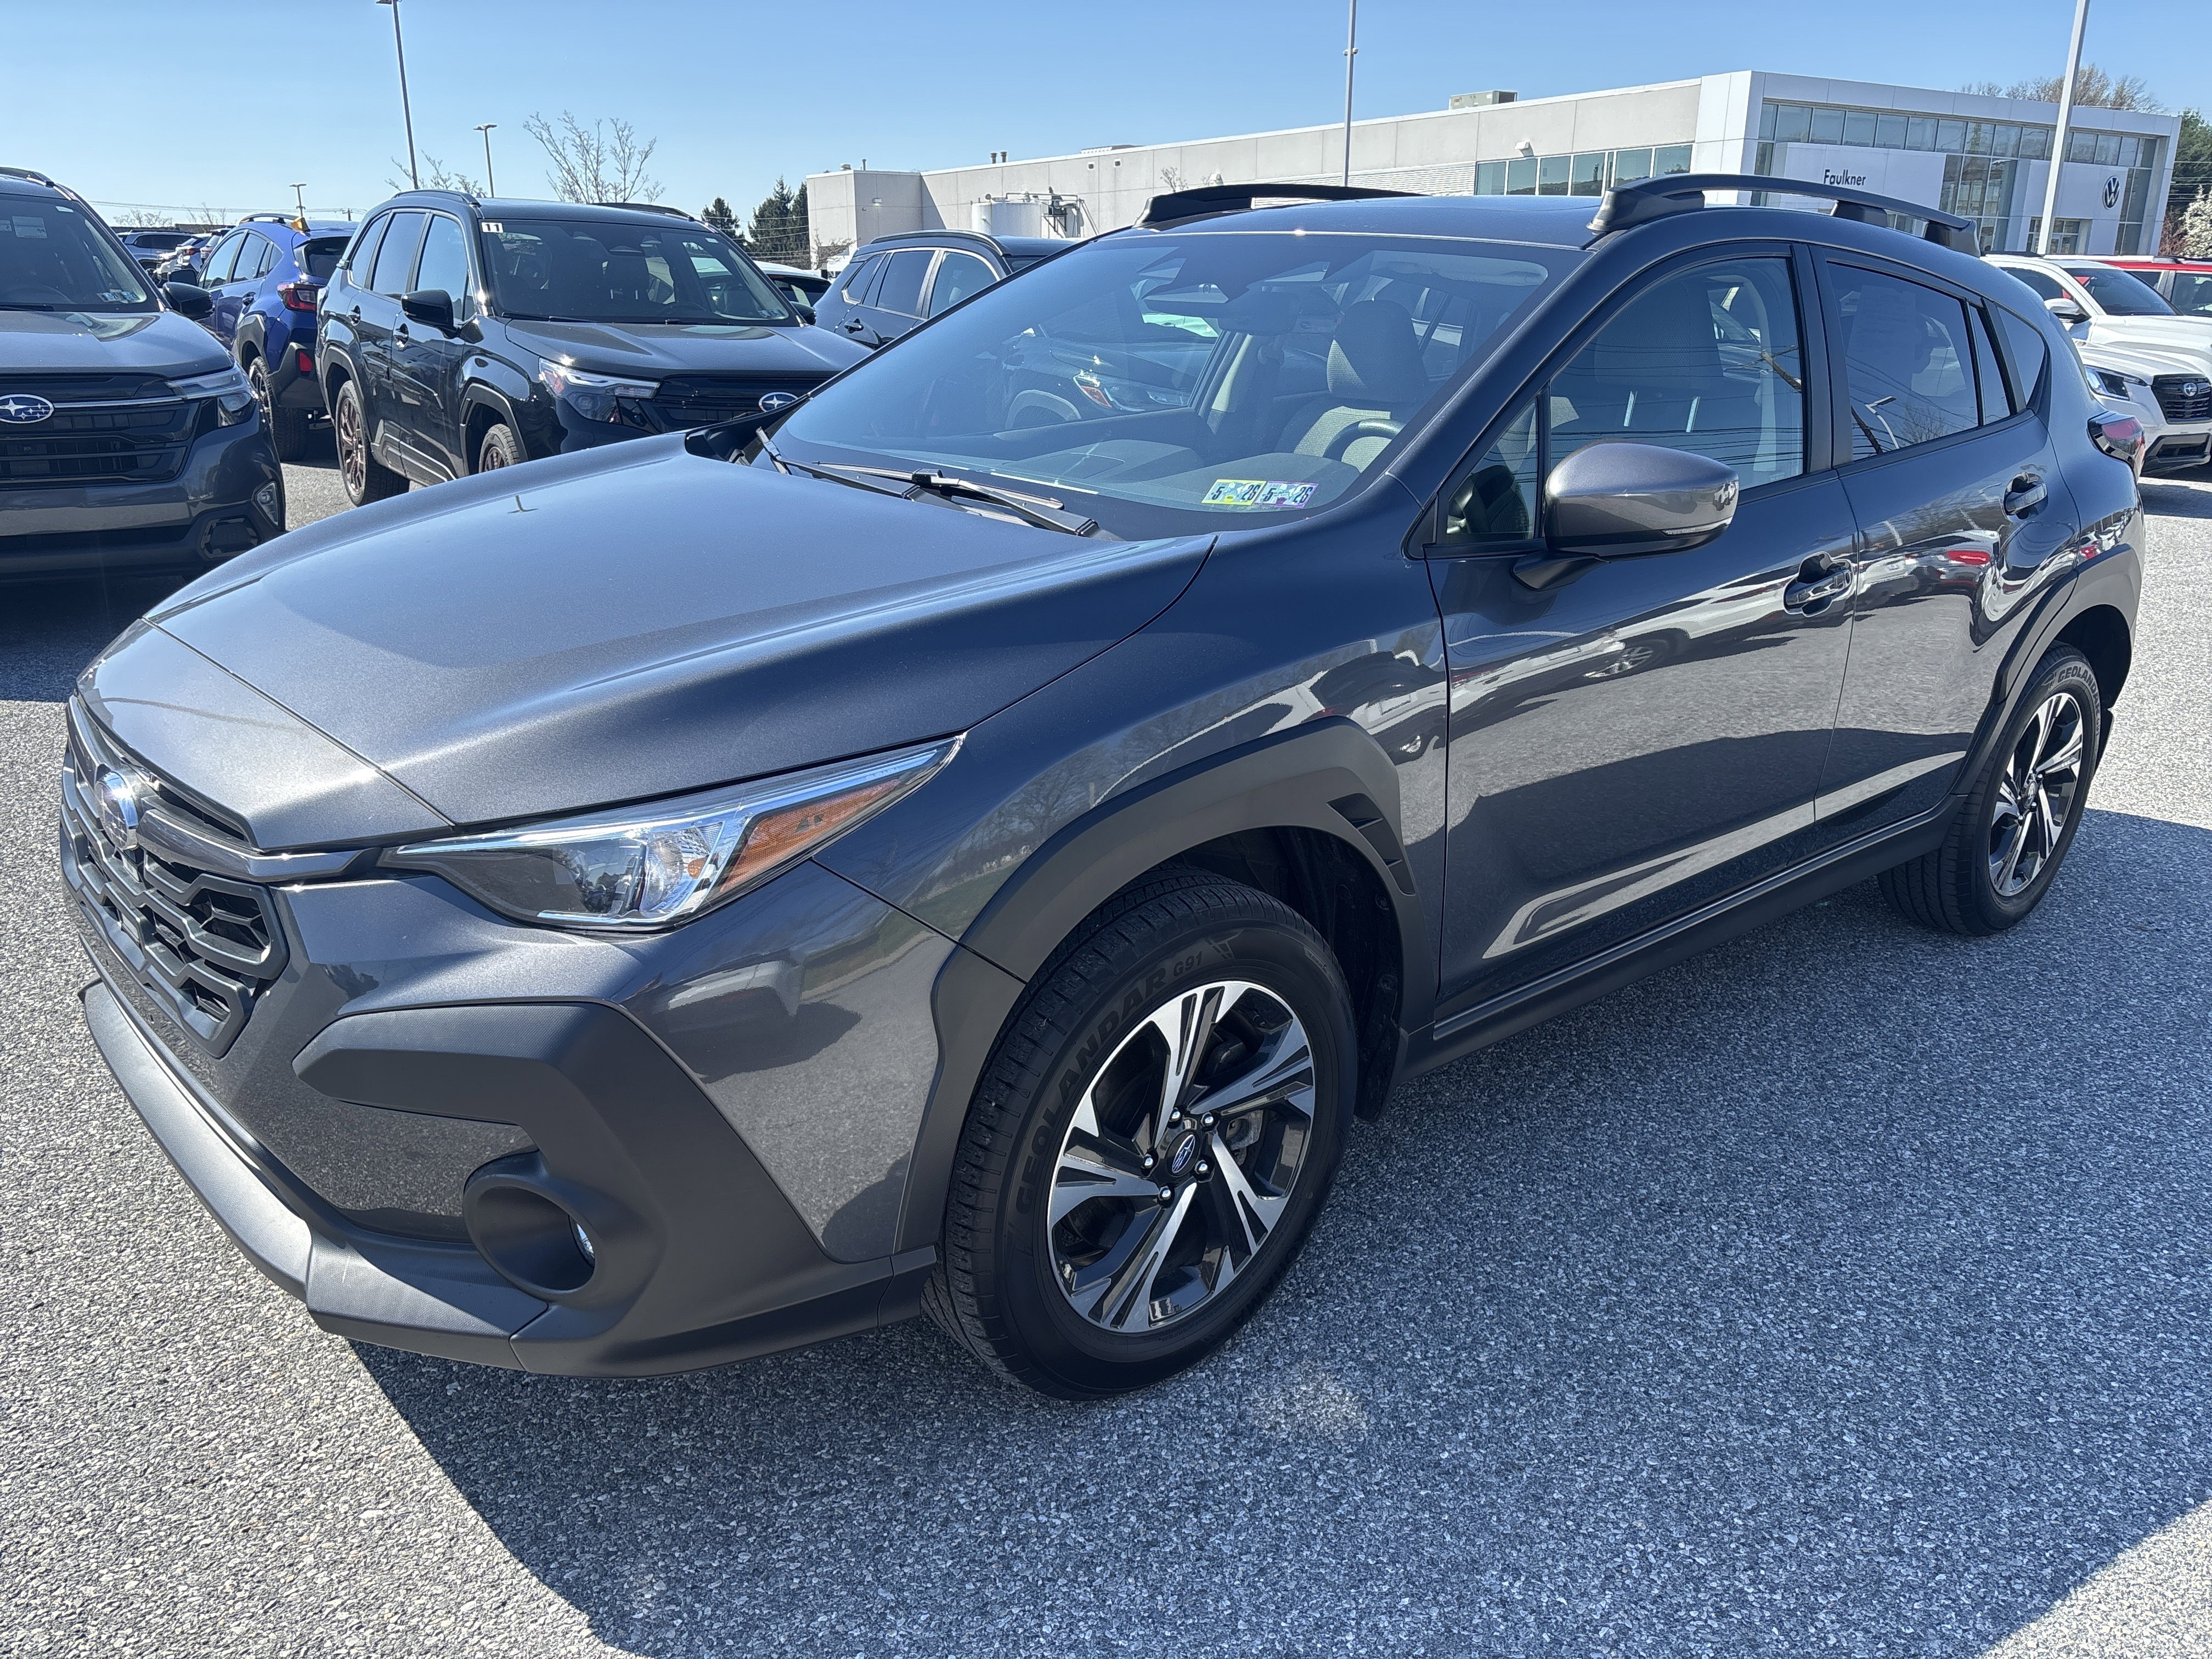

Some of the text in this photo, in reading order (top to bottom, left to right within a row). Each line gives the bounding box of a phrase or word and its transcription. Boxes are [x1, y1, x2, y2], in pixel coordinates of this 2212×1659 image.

[1824, 169, 1866, 185] Faulkner
[484, 223, 499, 232] 11
[1240, 484, 1261, 500] 26
[1293, 487, 1313, 503] 26
[2058, 665, 2100, 715] GEOLANDAR
[1015, 966, 1167, 1215] GEOLANDAR
[1173, 950, 1204, 976] G91
